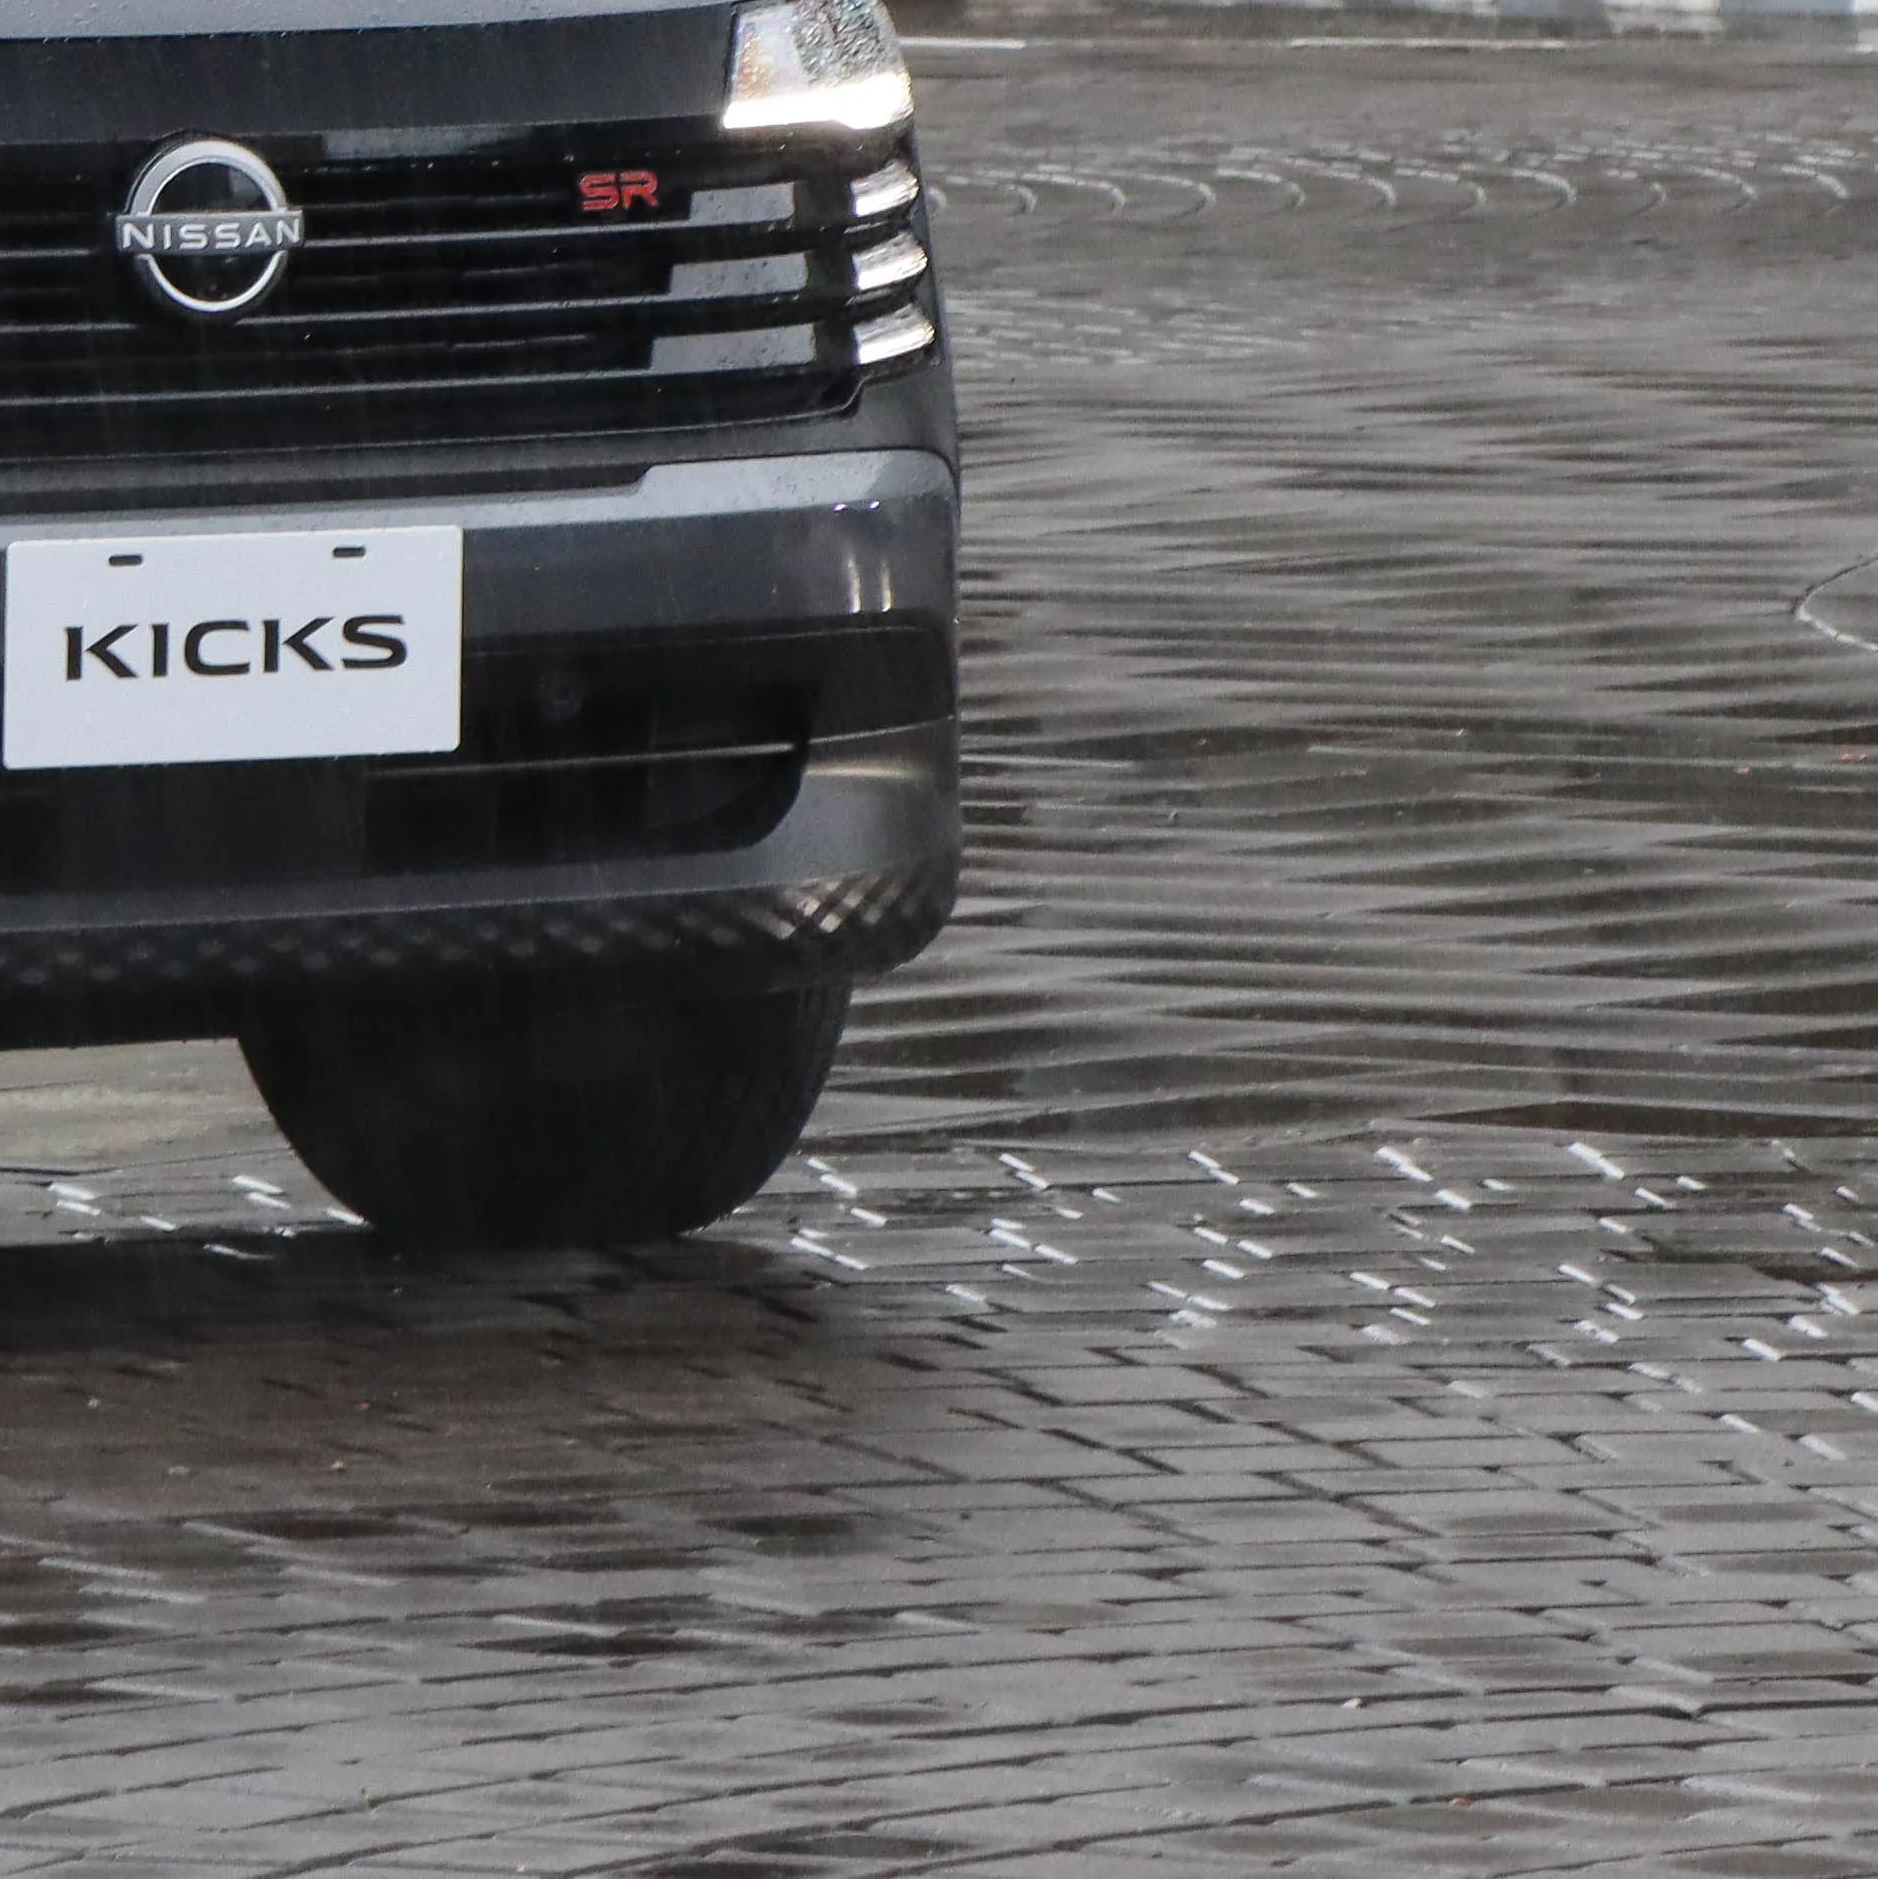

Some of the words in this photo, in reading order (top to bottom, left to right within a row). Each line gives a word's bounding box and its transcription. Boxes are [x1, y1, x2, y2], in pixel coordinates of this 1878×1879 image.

[578, 171, 658, 211] SR
[123, 218, 300, 250] NISSAN
[64, 614, 408, 682] KICKS
